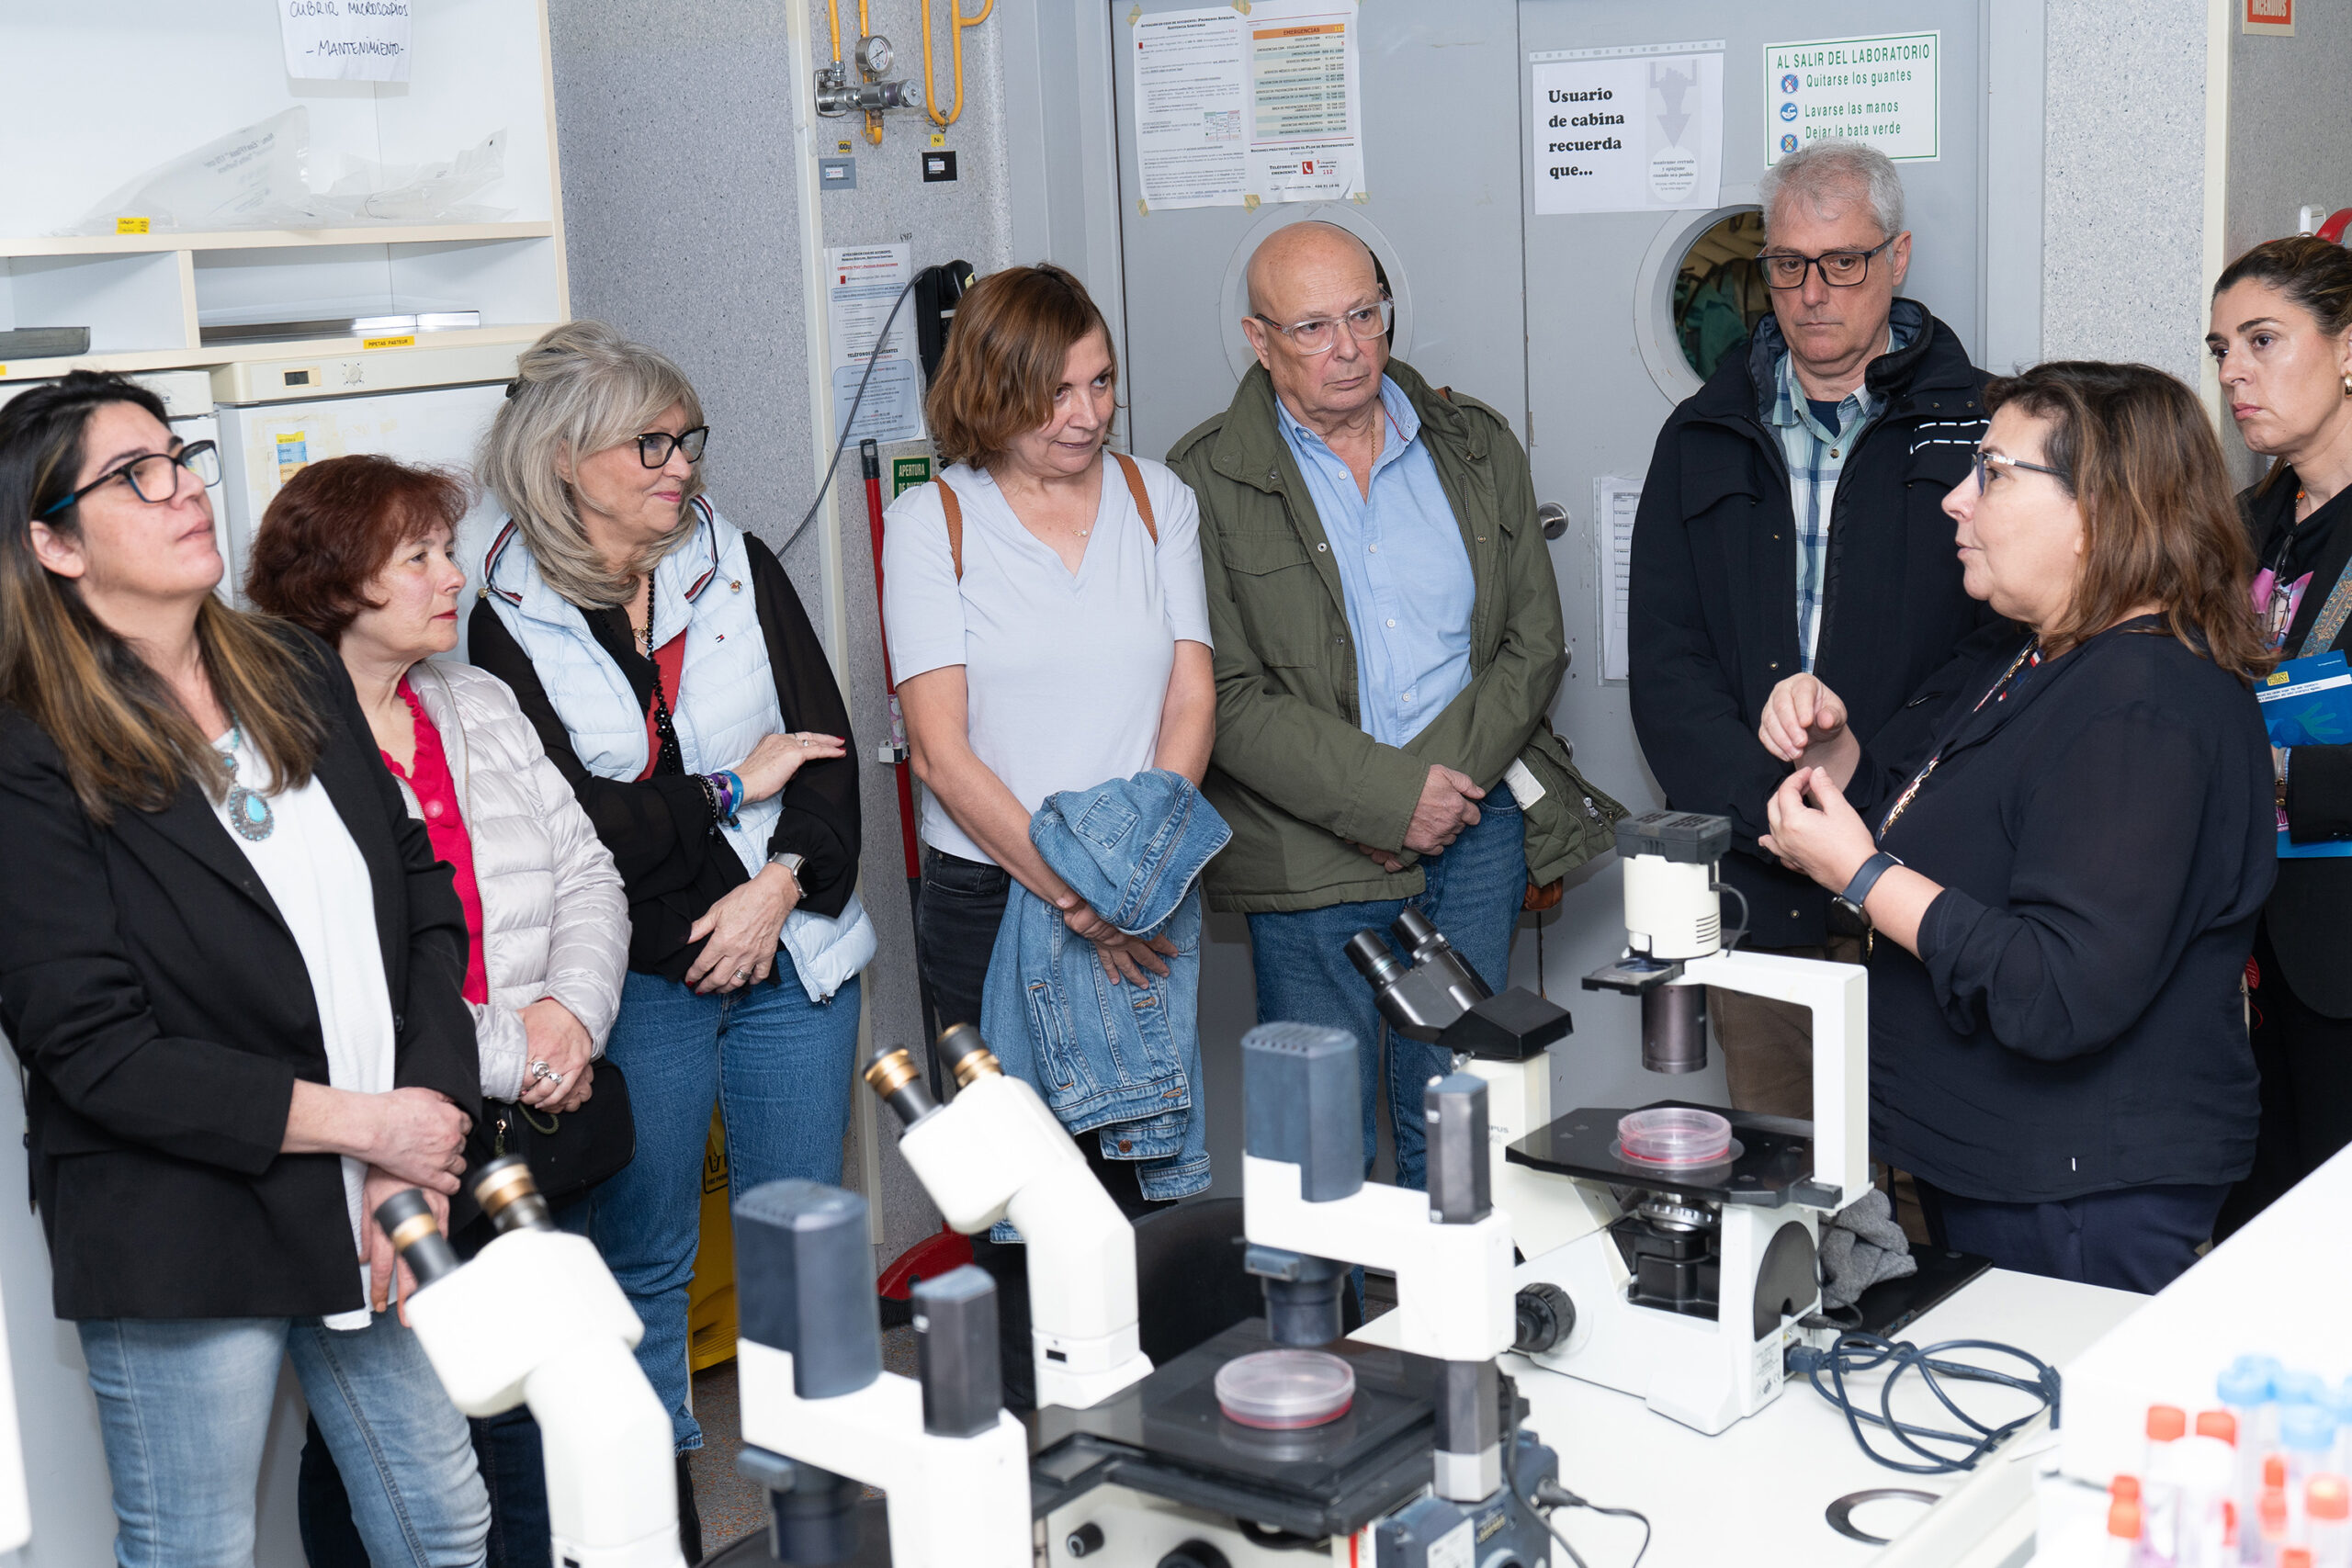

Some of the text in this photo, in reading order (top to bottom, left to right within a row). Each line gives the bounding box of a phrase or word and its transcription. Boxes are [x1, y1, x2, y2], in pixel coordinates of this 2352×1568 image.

[290, 0, 408, 17] CUBRIR MICROSCOPIOS
[1777, 44, 1930, 69] AL SALIR DEL LABORATORIO
[1807, 69, 1912, 88] Quitarse los guantes
[1548, 87, 1613, 103] Usuario
[1805, 101, 1899, 117] Lavarse las manos
[1549, 112, 1625, 128] de cabina
[1806, 121, 1901, 139] Dejar la bata verde
[1549, 137, 1622, 152] recuerda
[1549, 166, 1593, 180] que...
[899, 464, 925, 477] APERTURA
